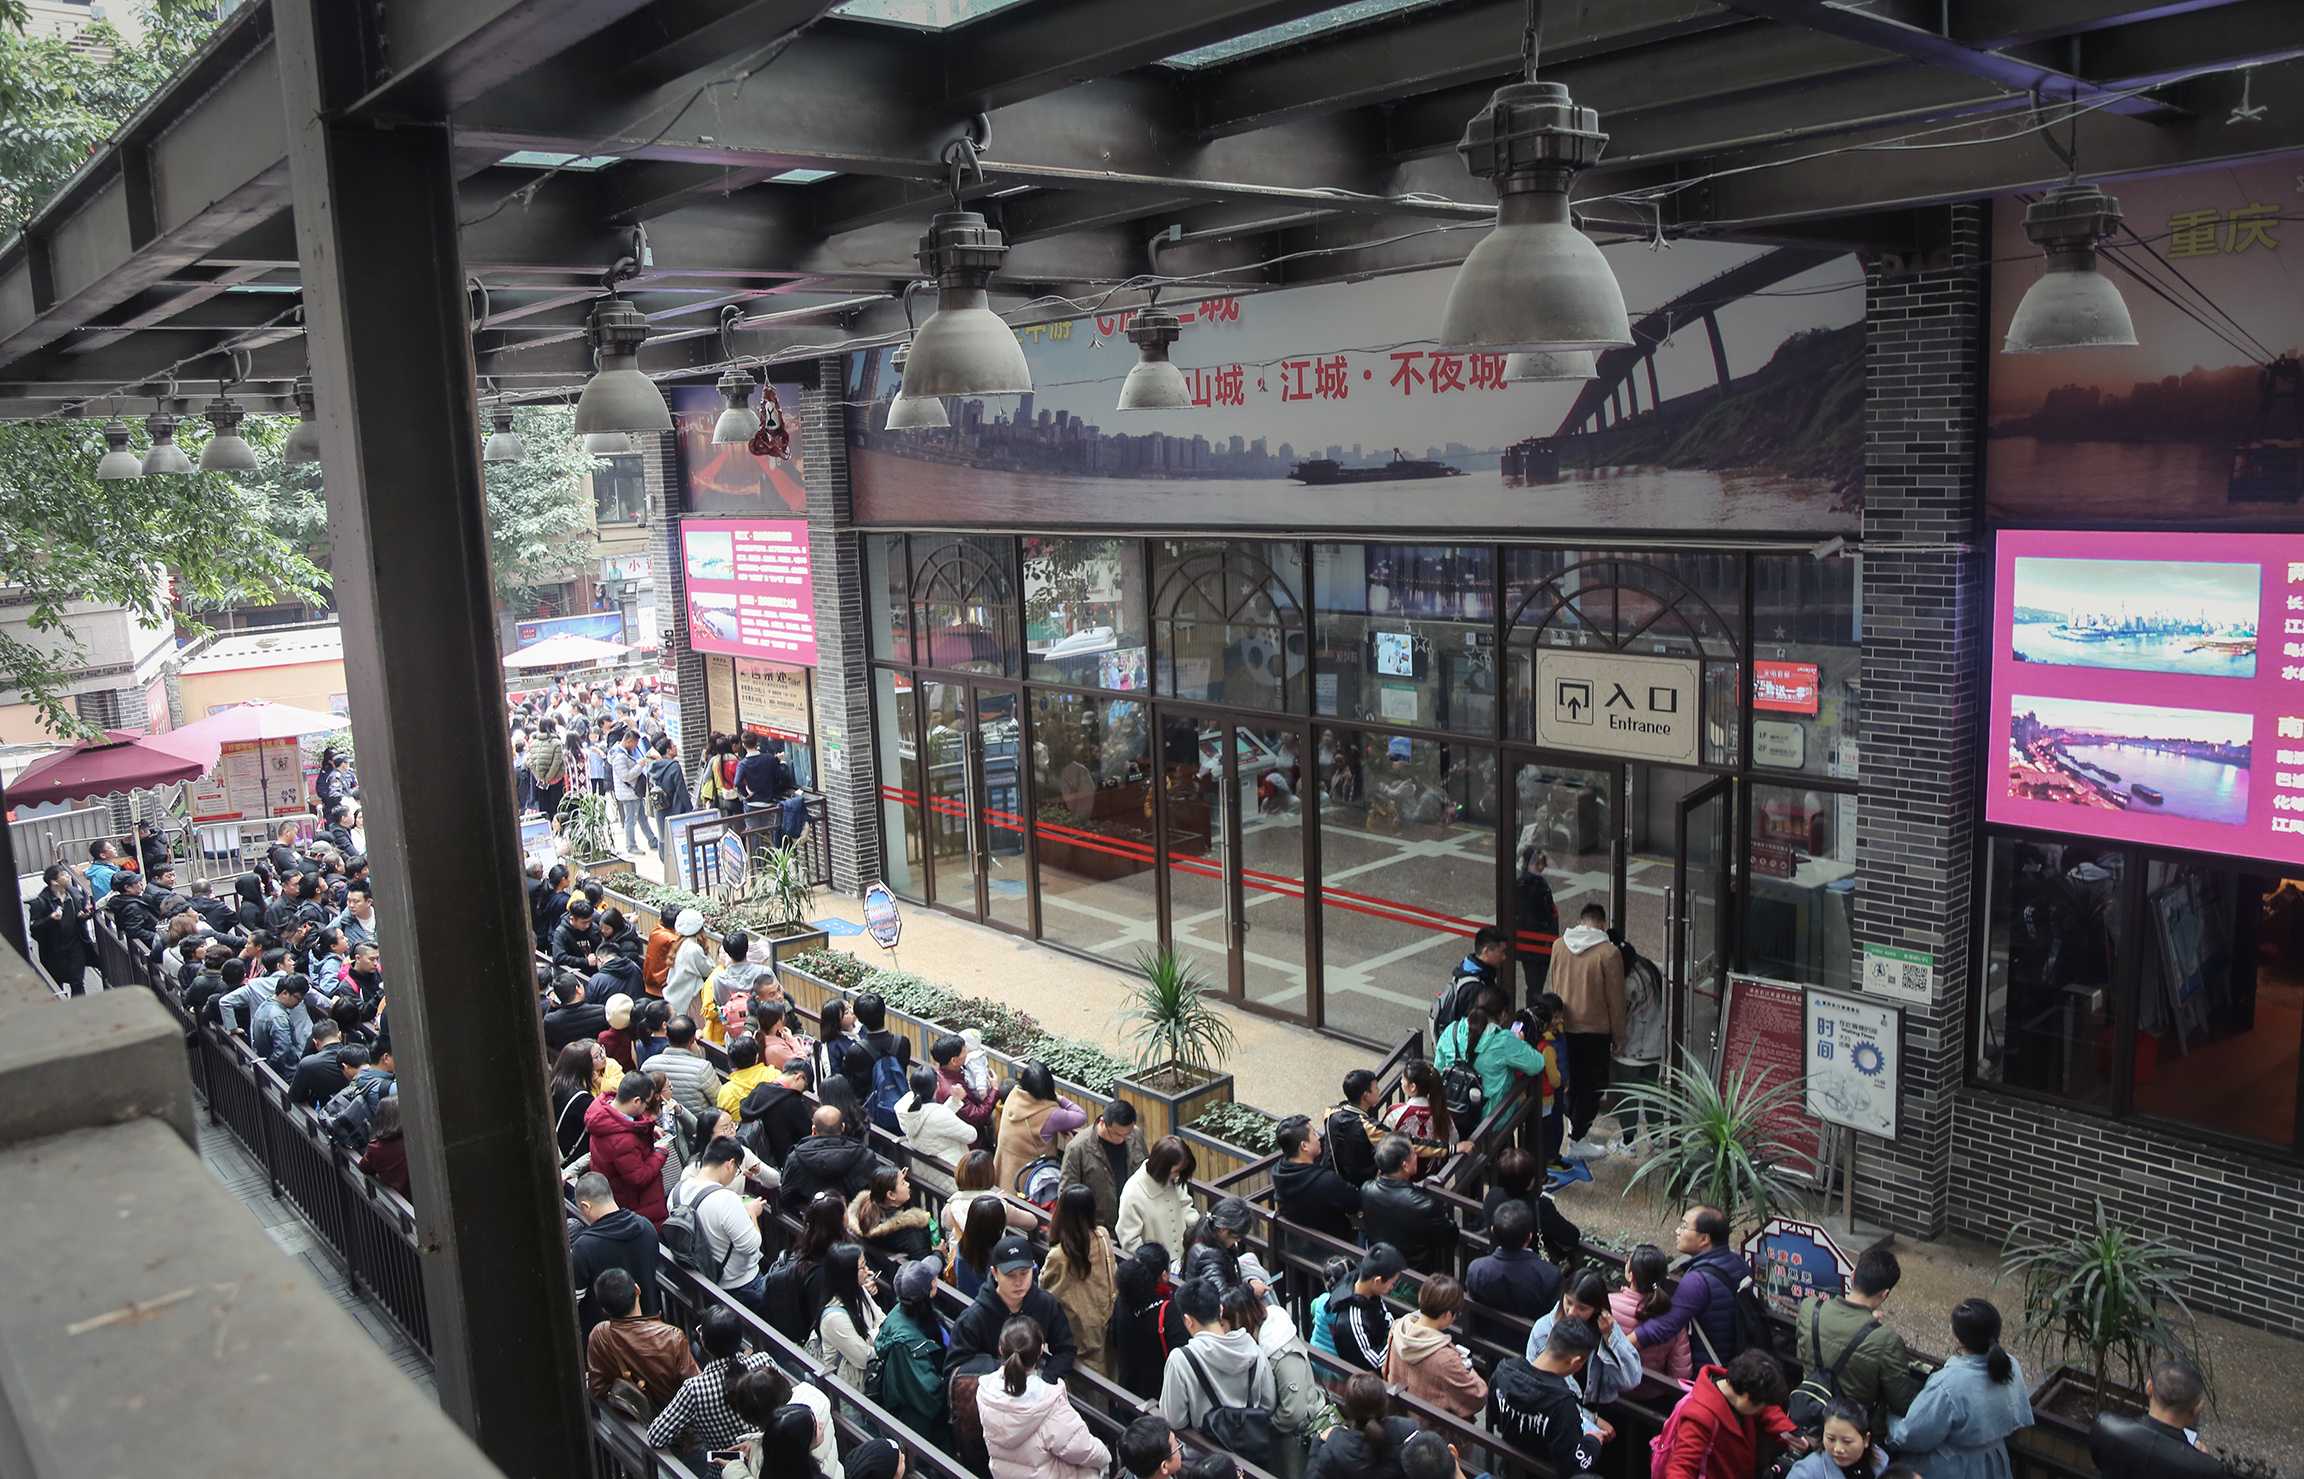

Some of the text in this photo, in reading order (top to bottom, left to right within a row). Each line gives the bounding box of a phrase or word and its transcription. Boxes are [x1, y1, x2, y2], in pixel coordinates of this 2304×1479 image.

[2166, 202, 2280, 259] 重庆
[1604, 683, 1677, 713] 入口
[1609, 713, 1671, 736] Entrance
[1817, 1017, 1834, 1061] 时间
